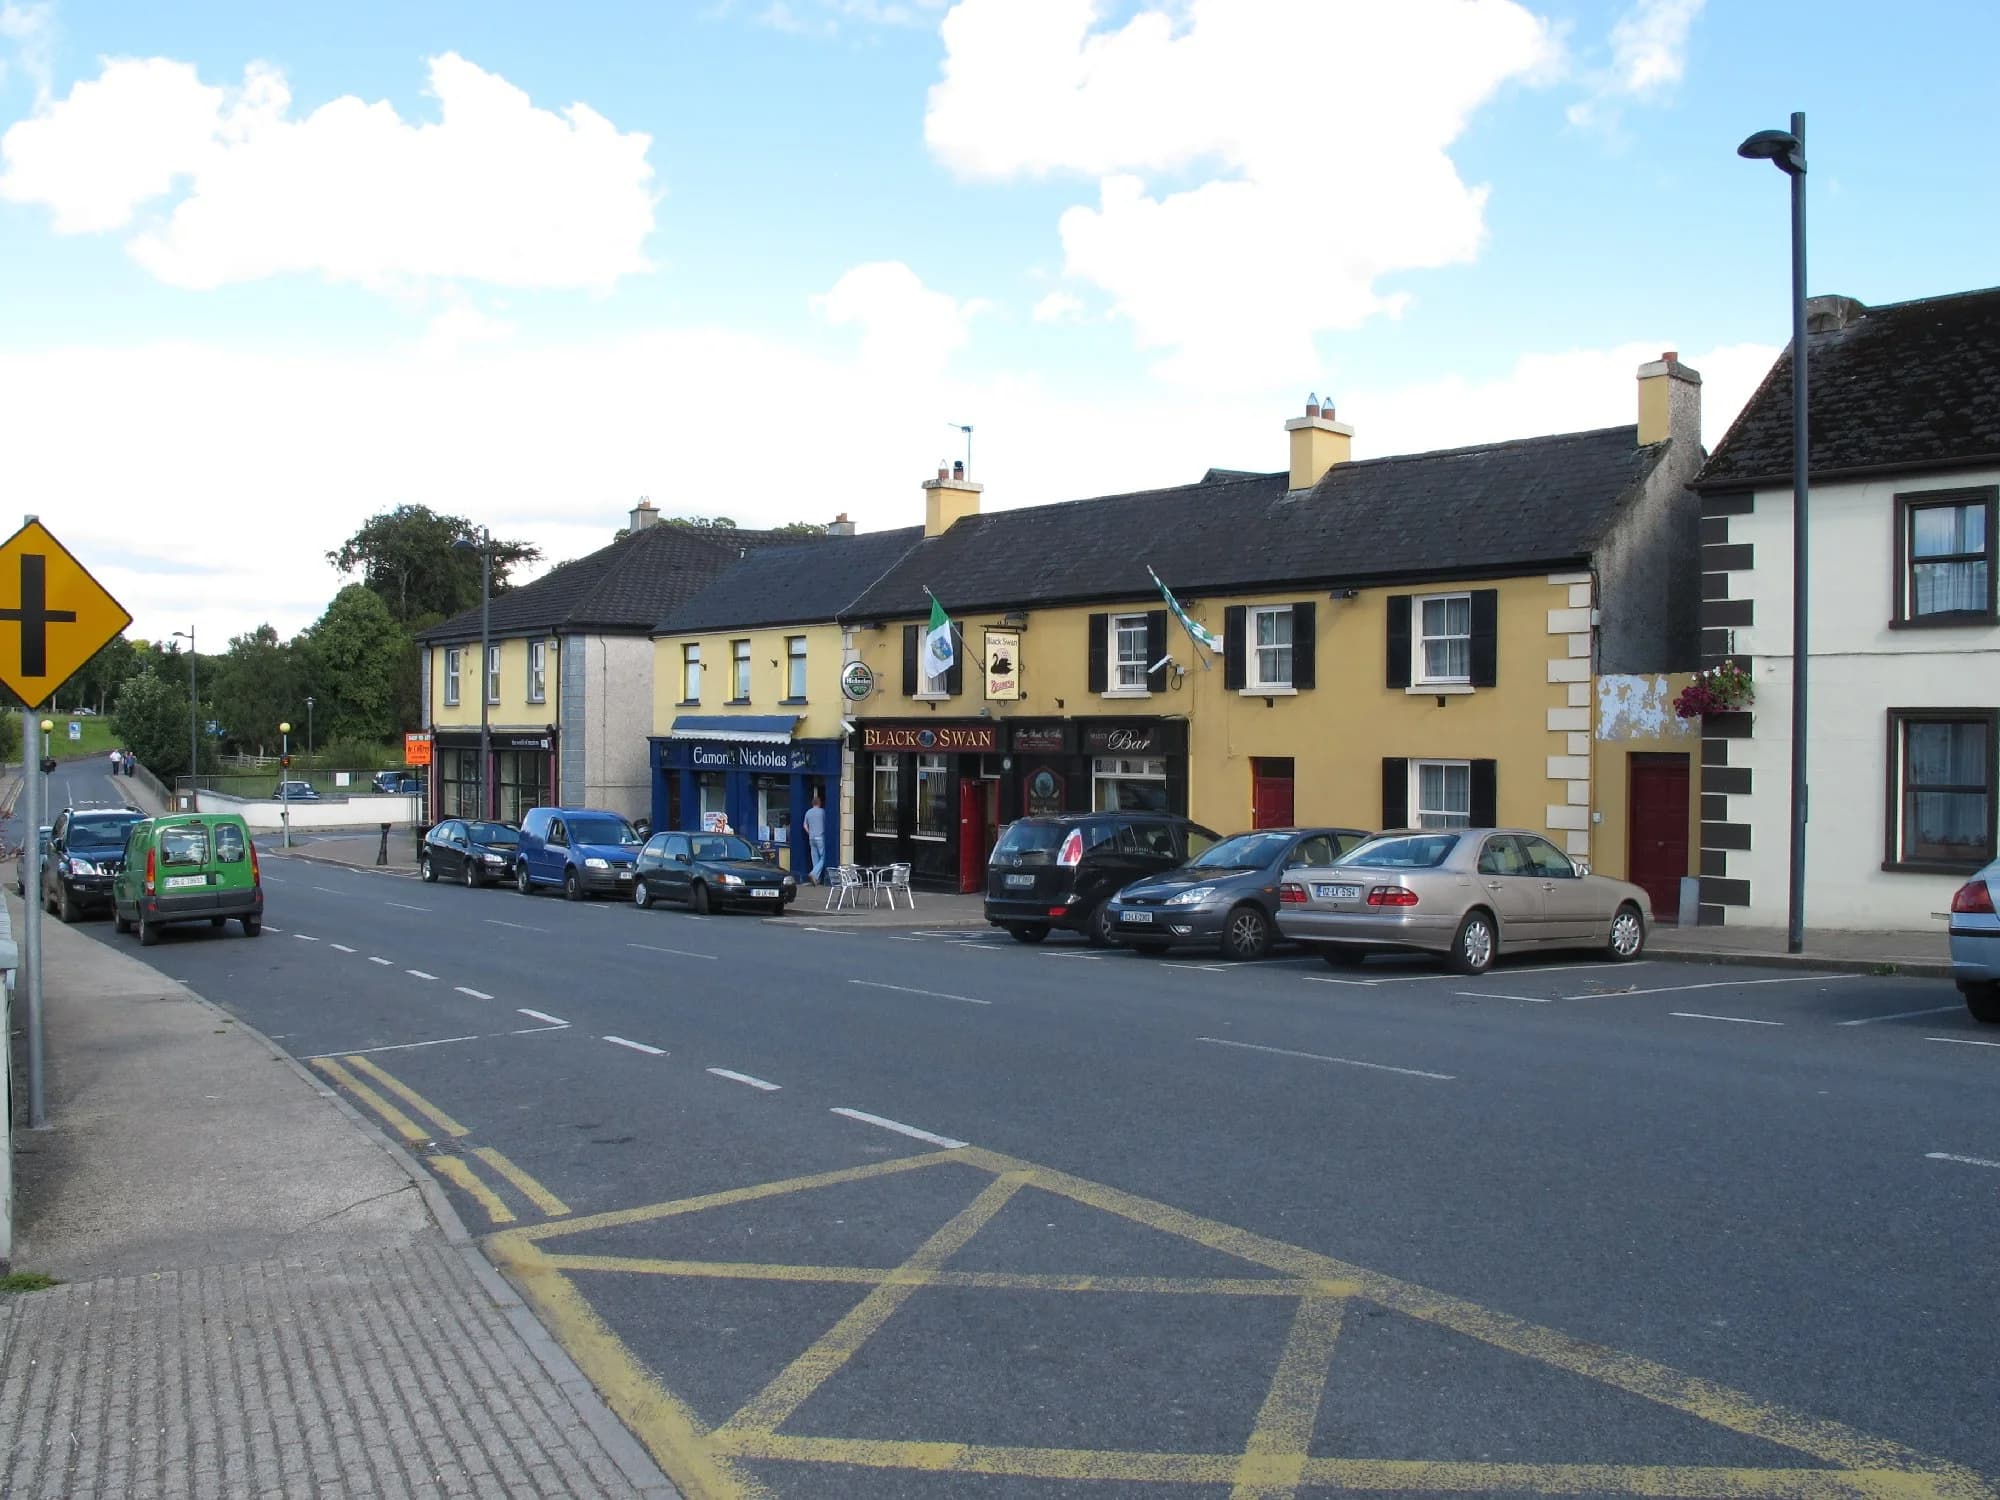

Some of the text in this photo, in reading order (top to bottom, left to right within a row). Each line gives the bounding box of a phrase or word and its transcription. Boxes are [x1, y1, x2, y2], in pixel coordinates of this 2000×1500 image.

[863, 728, 992, 747] BLACK SWAN
[1107, 729, 1150, 750] Bar
[693, 746, 737, 765] Eamon
[739, 747, 787, 767] Nicholas
